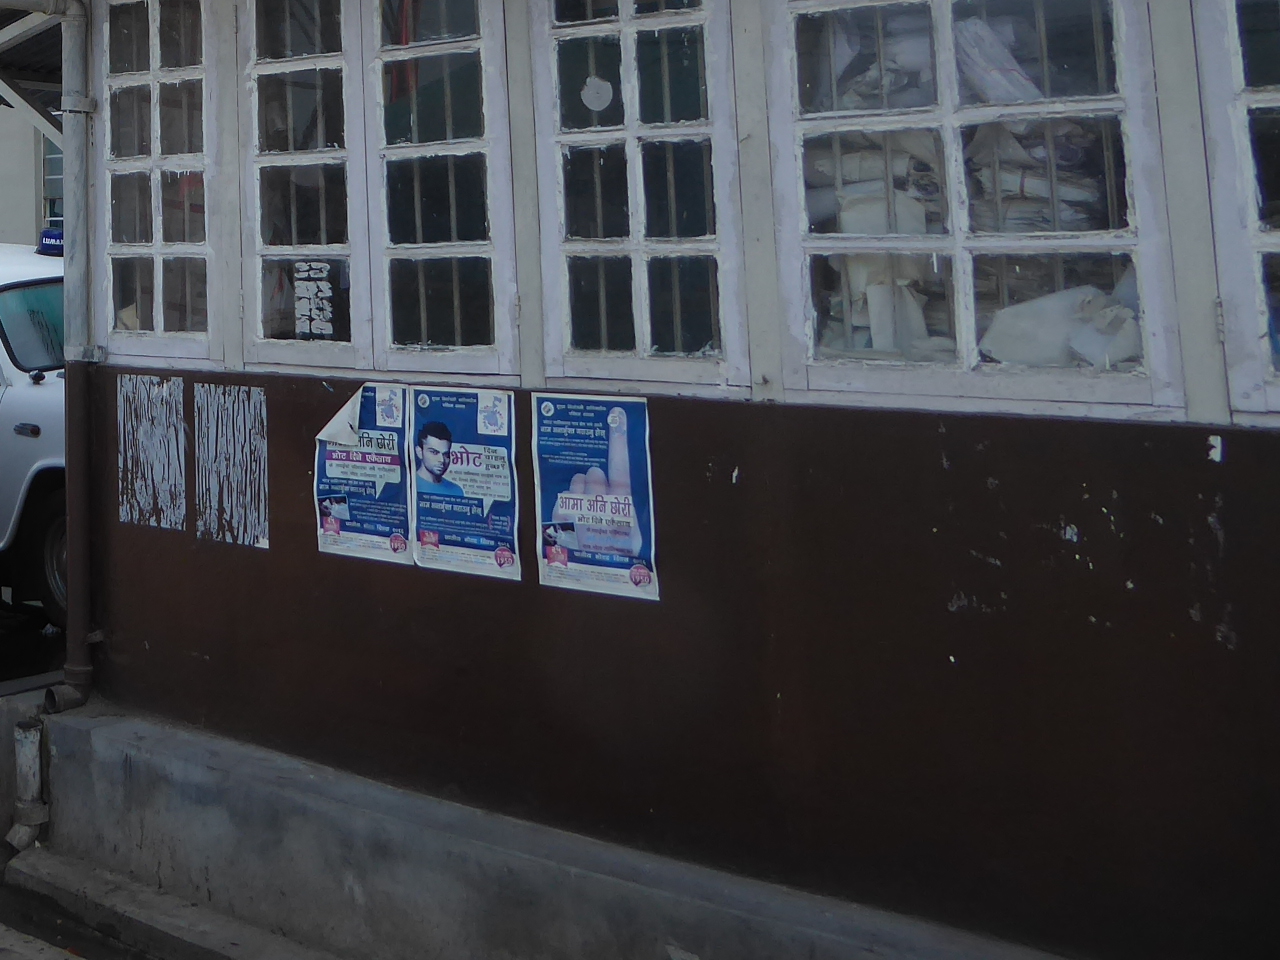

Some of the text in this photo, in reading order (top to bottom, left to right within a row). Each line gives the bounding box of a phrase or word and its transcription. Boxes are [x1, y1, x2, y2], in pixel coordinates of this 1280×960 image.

[450, 445, 483, 468] भोट
[559, 495, 631, 517] आमा अनि छोरी
[497, 557, 513, 566] 1950
[632, 574, 650, 583] 1950
